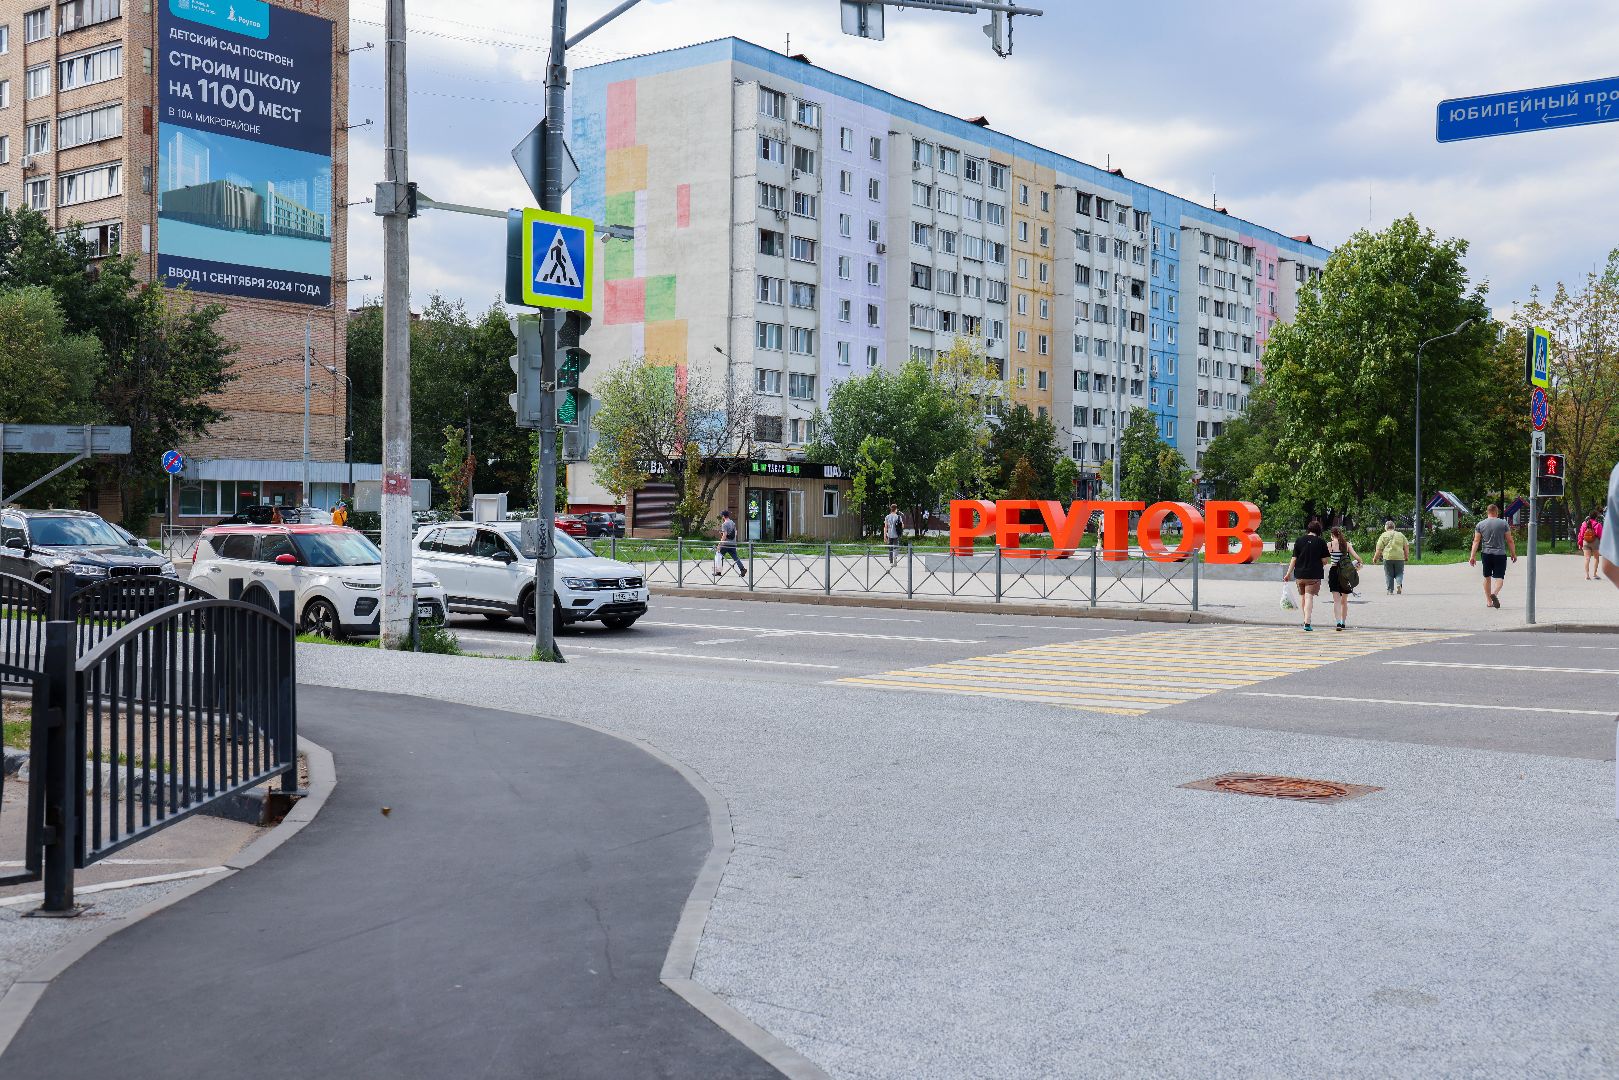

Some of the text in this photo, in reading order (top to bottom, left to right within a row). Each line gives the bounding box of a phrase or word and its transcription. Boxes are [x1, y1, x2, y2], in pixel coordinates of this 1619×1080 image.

[169, 27, 294, 67] ДЕТСКИЙ САД ПОСТРОЕН
[169, 50, 301, 94] СТРОИМ ШКОЛУ
[169, 78, 302, 123] НА 1100 МЕСТ
[1450, 90, 1579, 122] ЮБИЛЕЙНЫЙ
[1513, 104, 1612, 128] 1 17
[169, 106, 261, 135] В 10А МИКРОРАЙОНЕ
[168, 266, 321, 296] ВВОД 1 СЕНТЯБРЯ 2024 ГОДА
[949, 499, 1263, 564] РЕУТОВ
